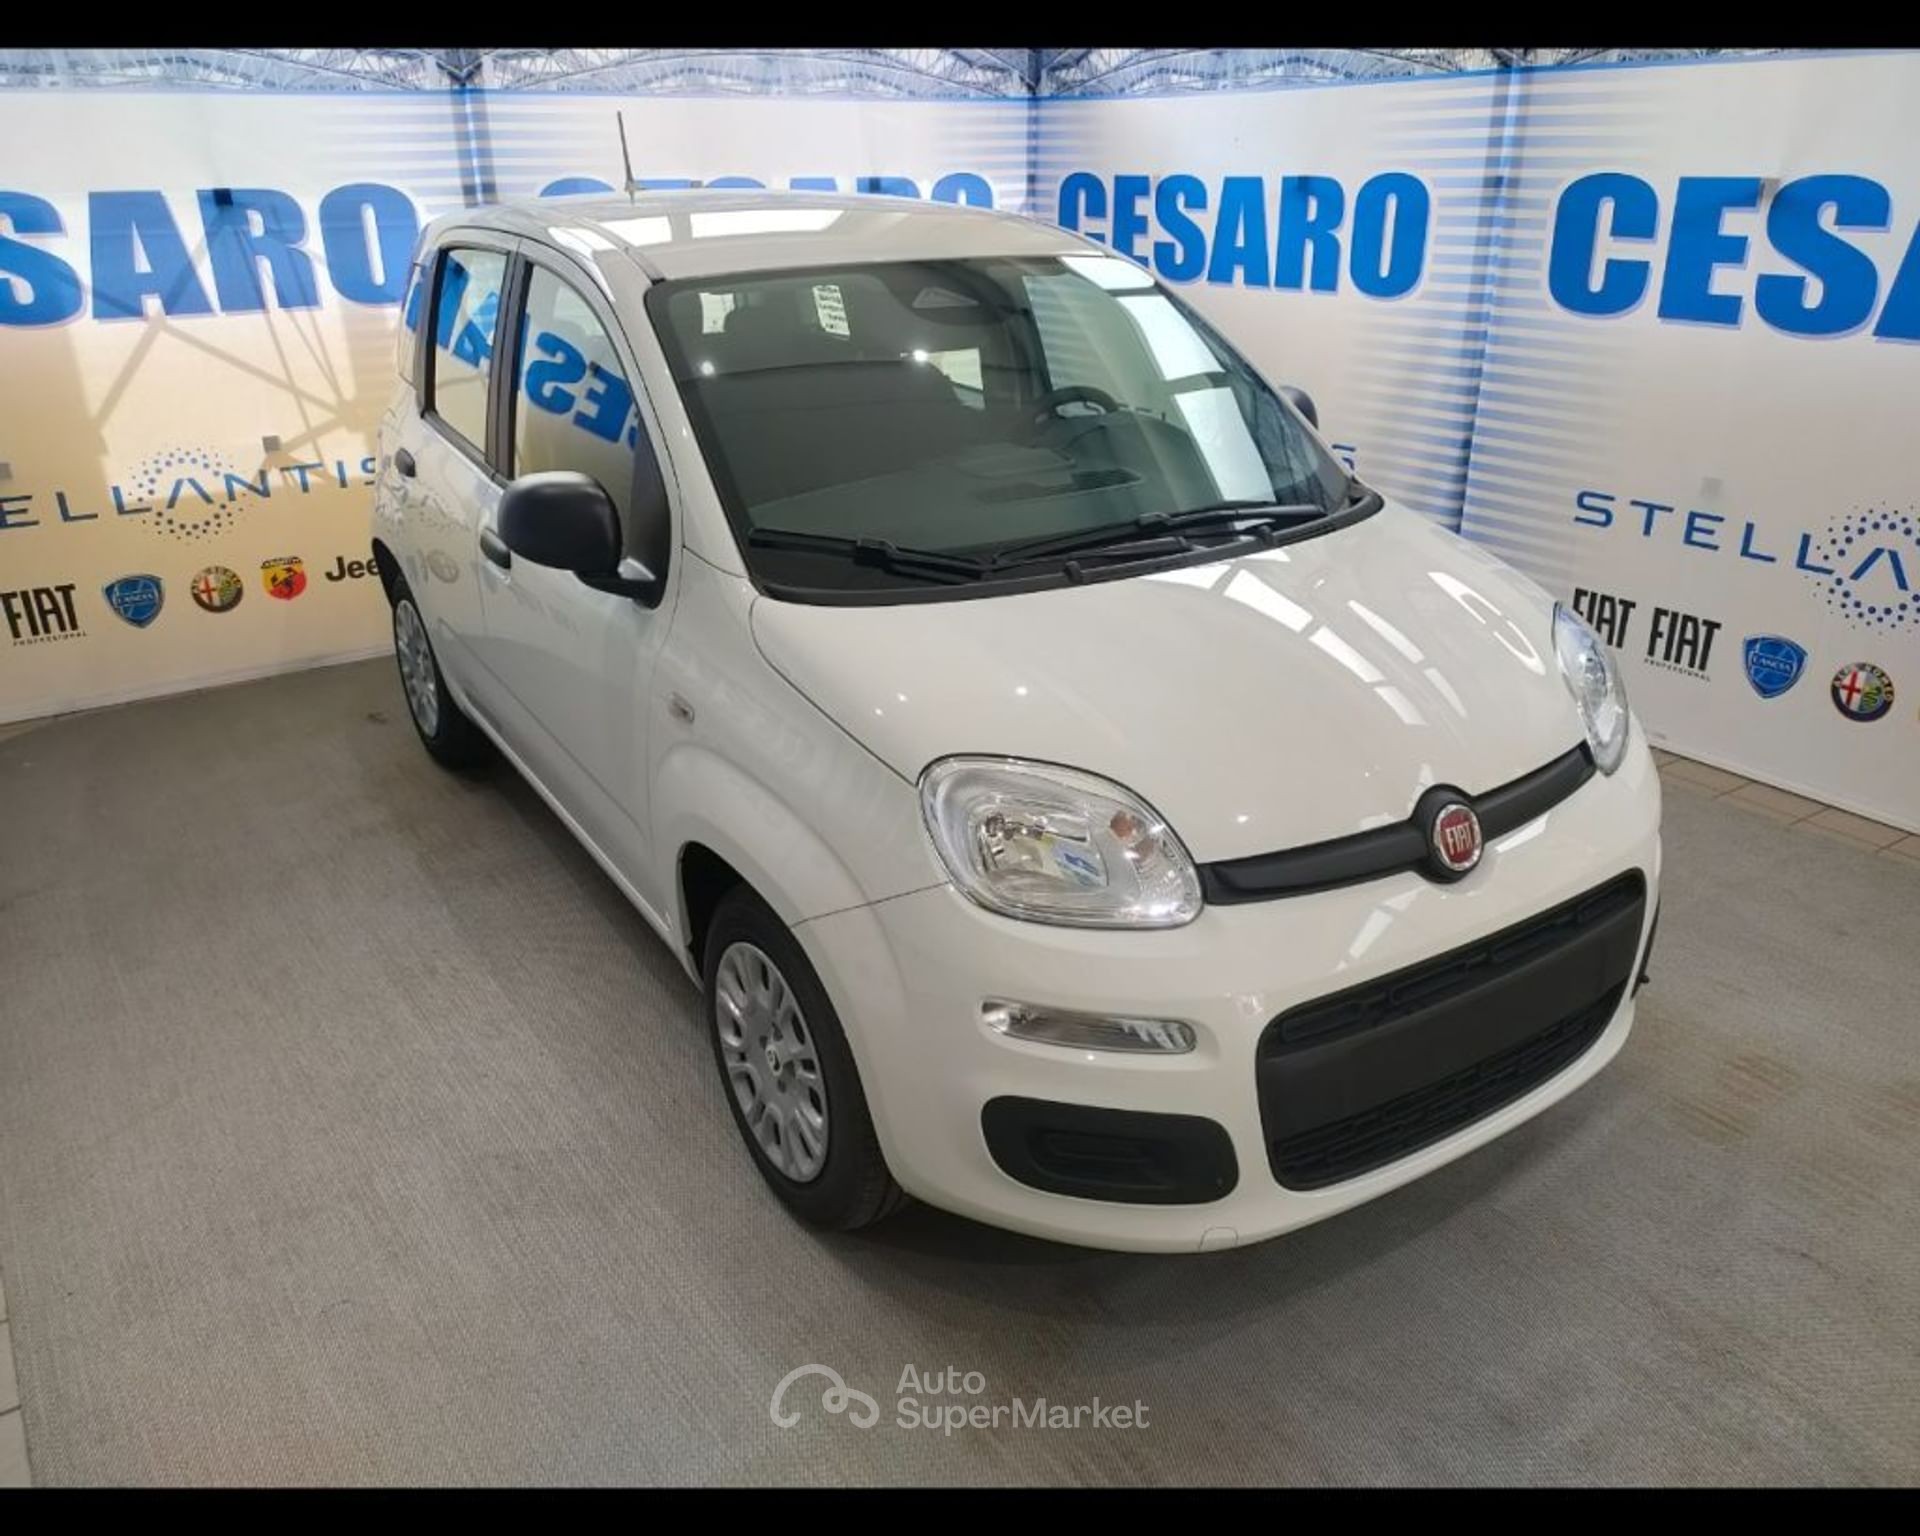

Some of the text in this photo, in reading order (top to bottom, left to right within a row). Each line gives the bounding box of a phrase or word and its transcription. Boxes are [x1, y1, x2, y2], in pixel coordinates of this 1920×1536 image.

[0, 182, 418, 327] SARO
[1058, 171, 1430, 298] CESARO
[325, 556, 379, 582] Jee
[1574, 490, 1909, 592] STELLA
[0, 584, 78, 639] FIAT
[1572, 587, 1636, 649] FIAT
[1647, 606, 1722, 671] FIAT
